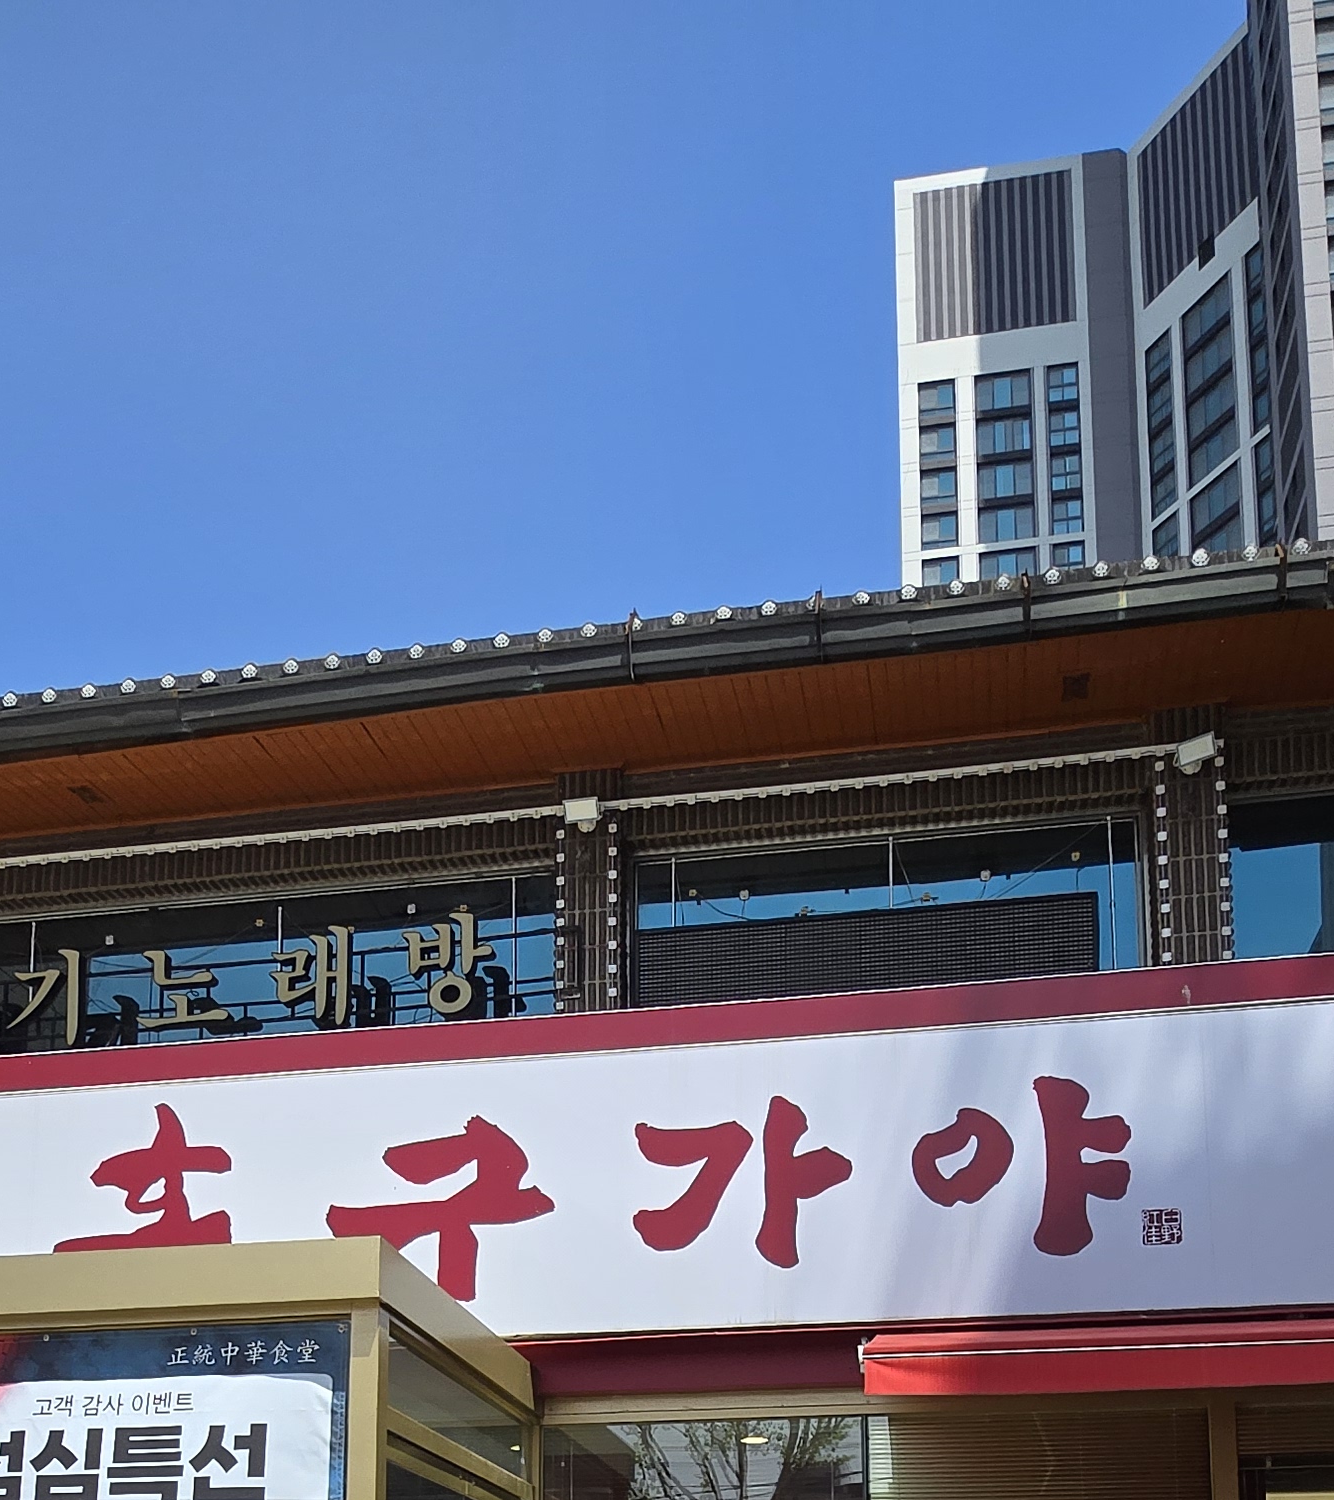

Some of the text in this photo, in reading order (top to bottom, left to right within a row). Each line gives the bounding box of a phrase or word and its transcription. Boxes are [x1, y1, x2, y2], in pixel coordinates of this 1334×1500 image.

[166, 1338, 320, 1367] 正統中華食堂
[32, 1391, 194, 1417] 고객 감사 이벤트
